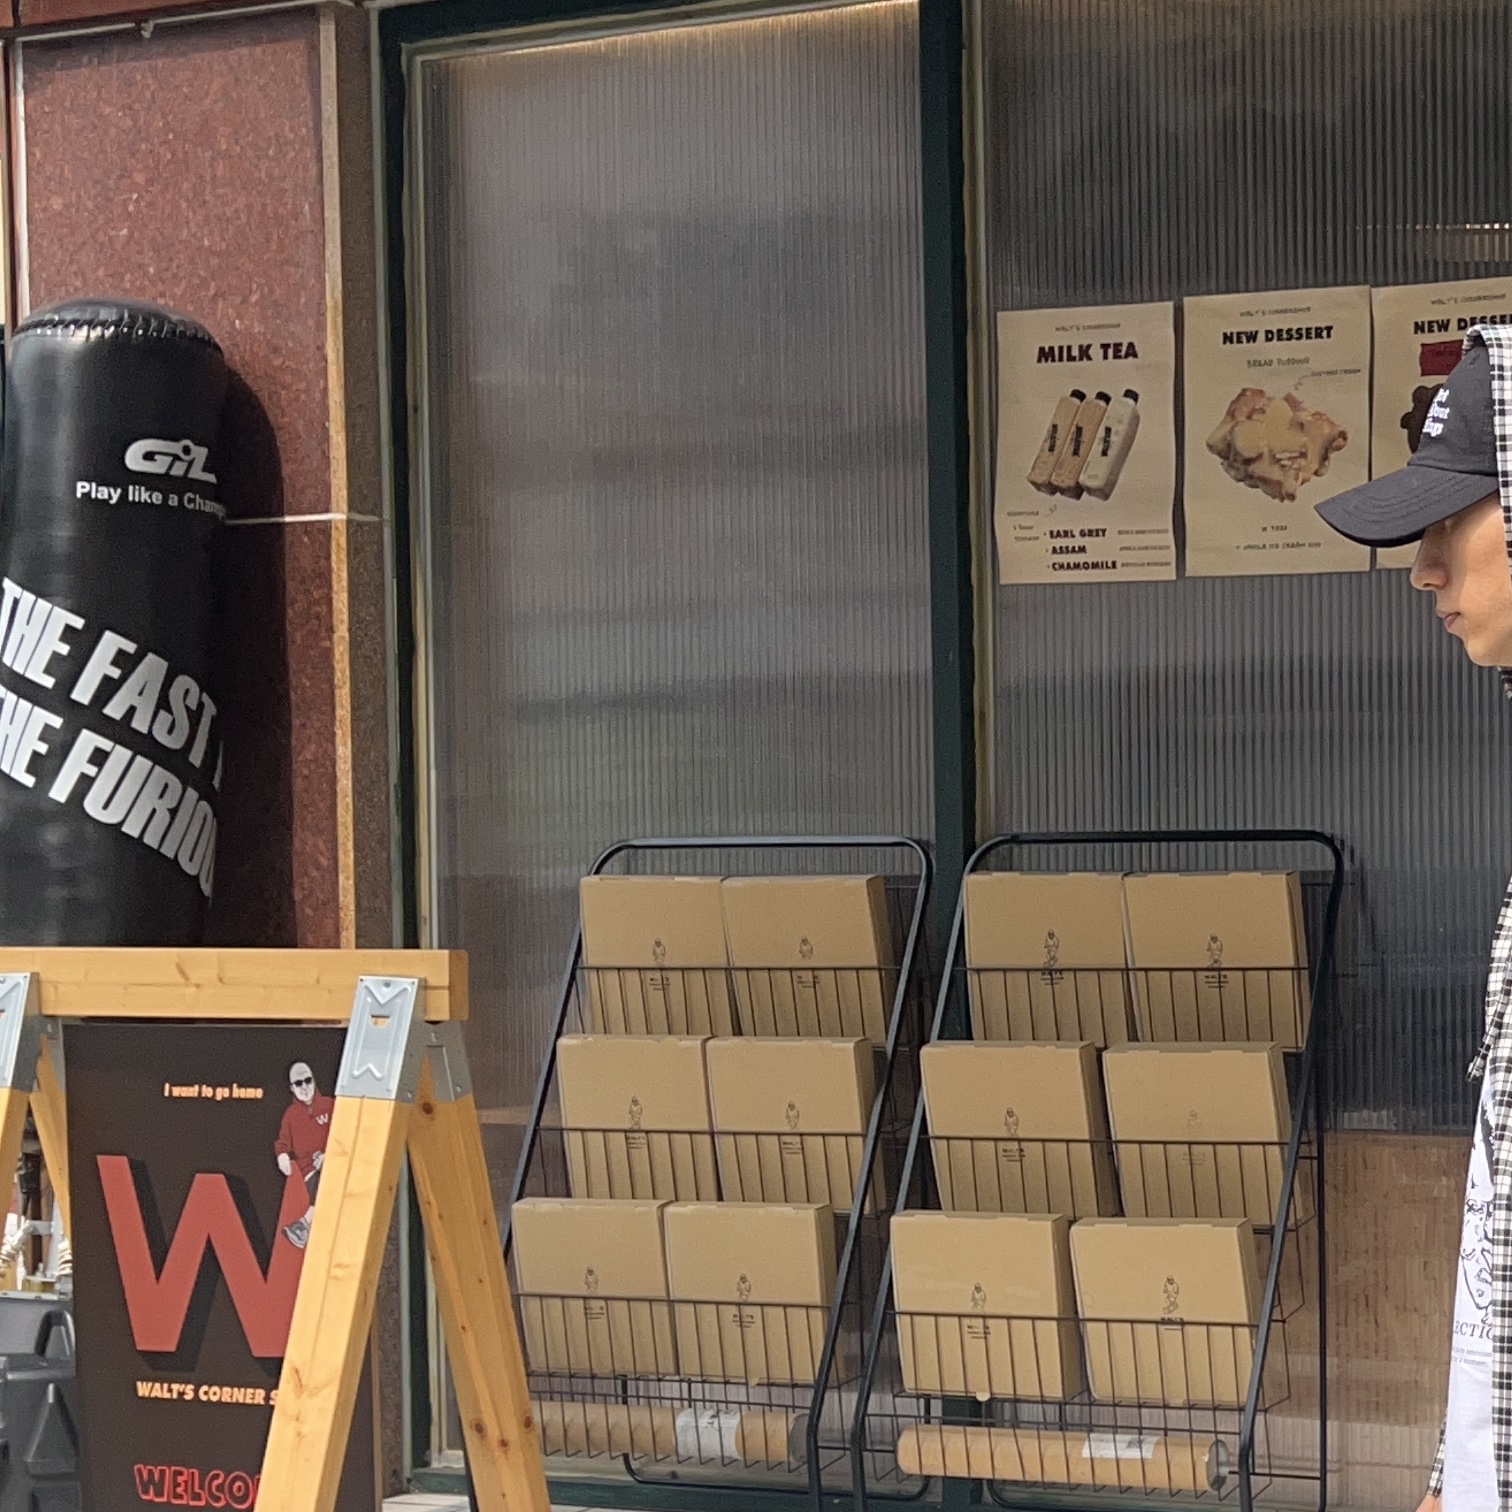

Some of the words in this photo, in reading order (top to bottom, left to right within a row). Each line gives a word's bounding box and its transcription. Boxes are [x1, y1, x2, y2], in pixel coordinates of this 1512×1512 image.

[1222, 330, 1259, 345] NEW
[1265, 325, 1334, 343] DESSERT
[1413, 319, 1451, 335] NEW
[1036, 343, 1093, 364] MILK
[1100, 341, 1138, 361] TEA
[75, 480, 122, 505] Play
[128, 484, 163, 505] like
[168, 493, 178, 507] a
[1050, 529, 1076, 539] EARL
[1079, 528, 1107, 538] GREY
[1051, 545, 1087, 555] ASSAM
[1052, 560, 1117, 571] CHAMOMILE
[0, 577, 85, 690] THE
[69, 629, 217, 769] FAST
[0, 683, 64, 788] HE
[164, 1082, 170, 1097] I
[171, 1085, 199, 1098] want
[201, 1084, 214, 1098] to
[215, 1088, 230, 1101] go
[232, 1083, 263, 1099] home
[136, 1381, 195, 1400] WALT'S
[198, 1385, 266, 1405] CORNER
[134, 1464, 261, 1510] WELCO
